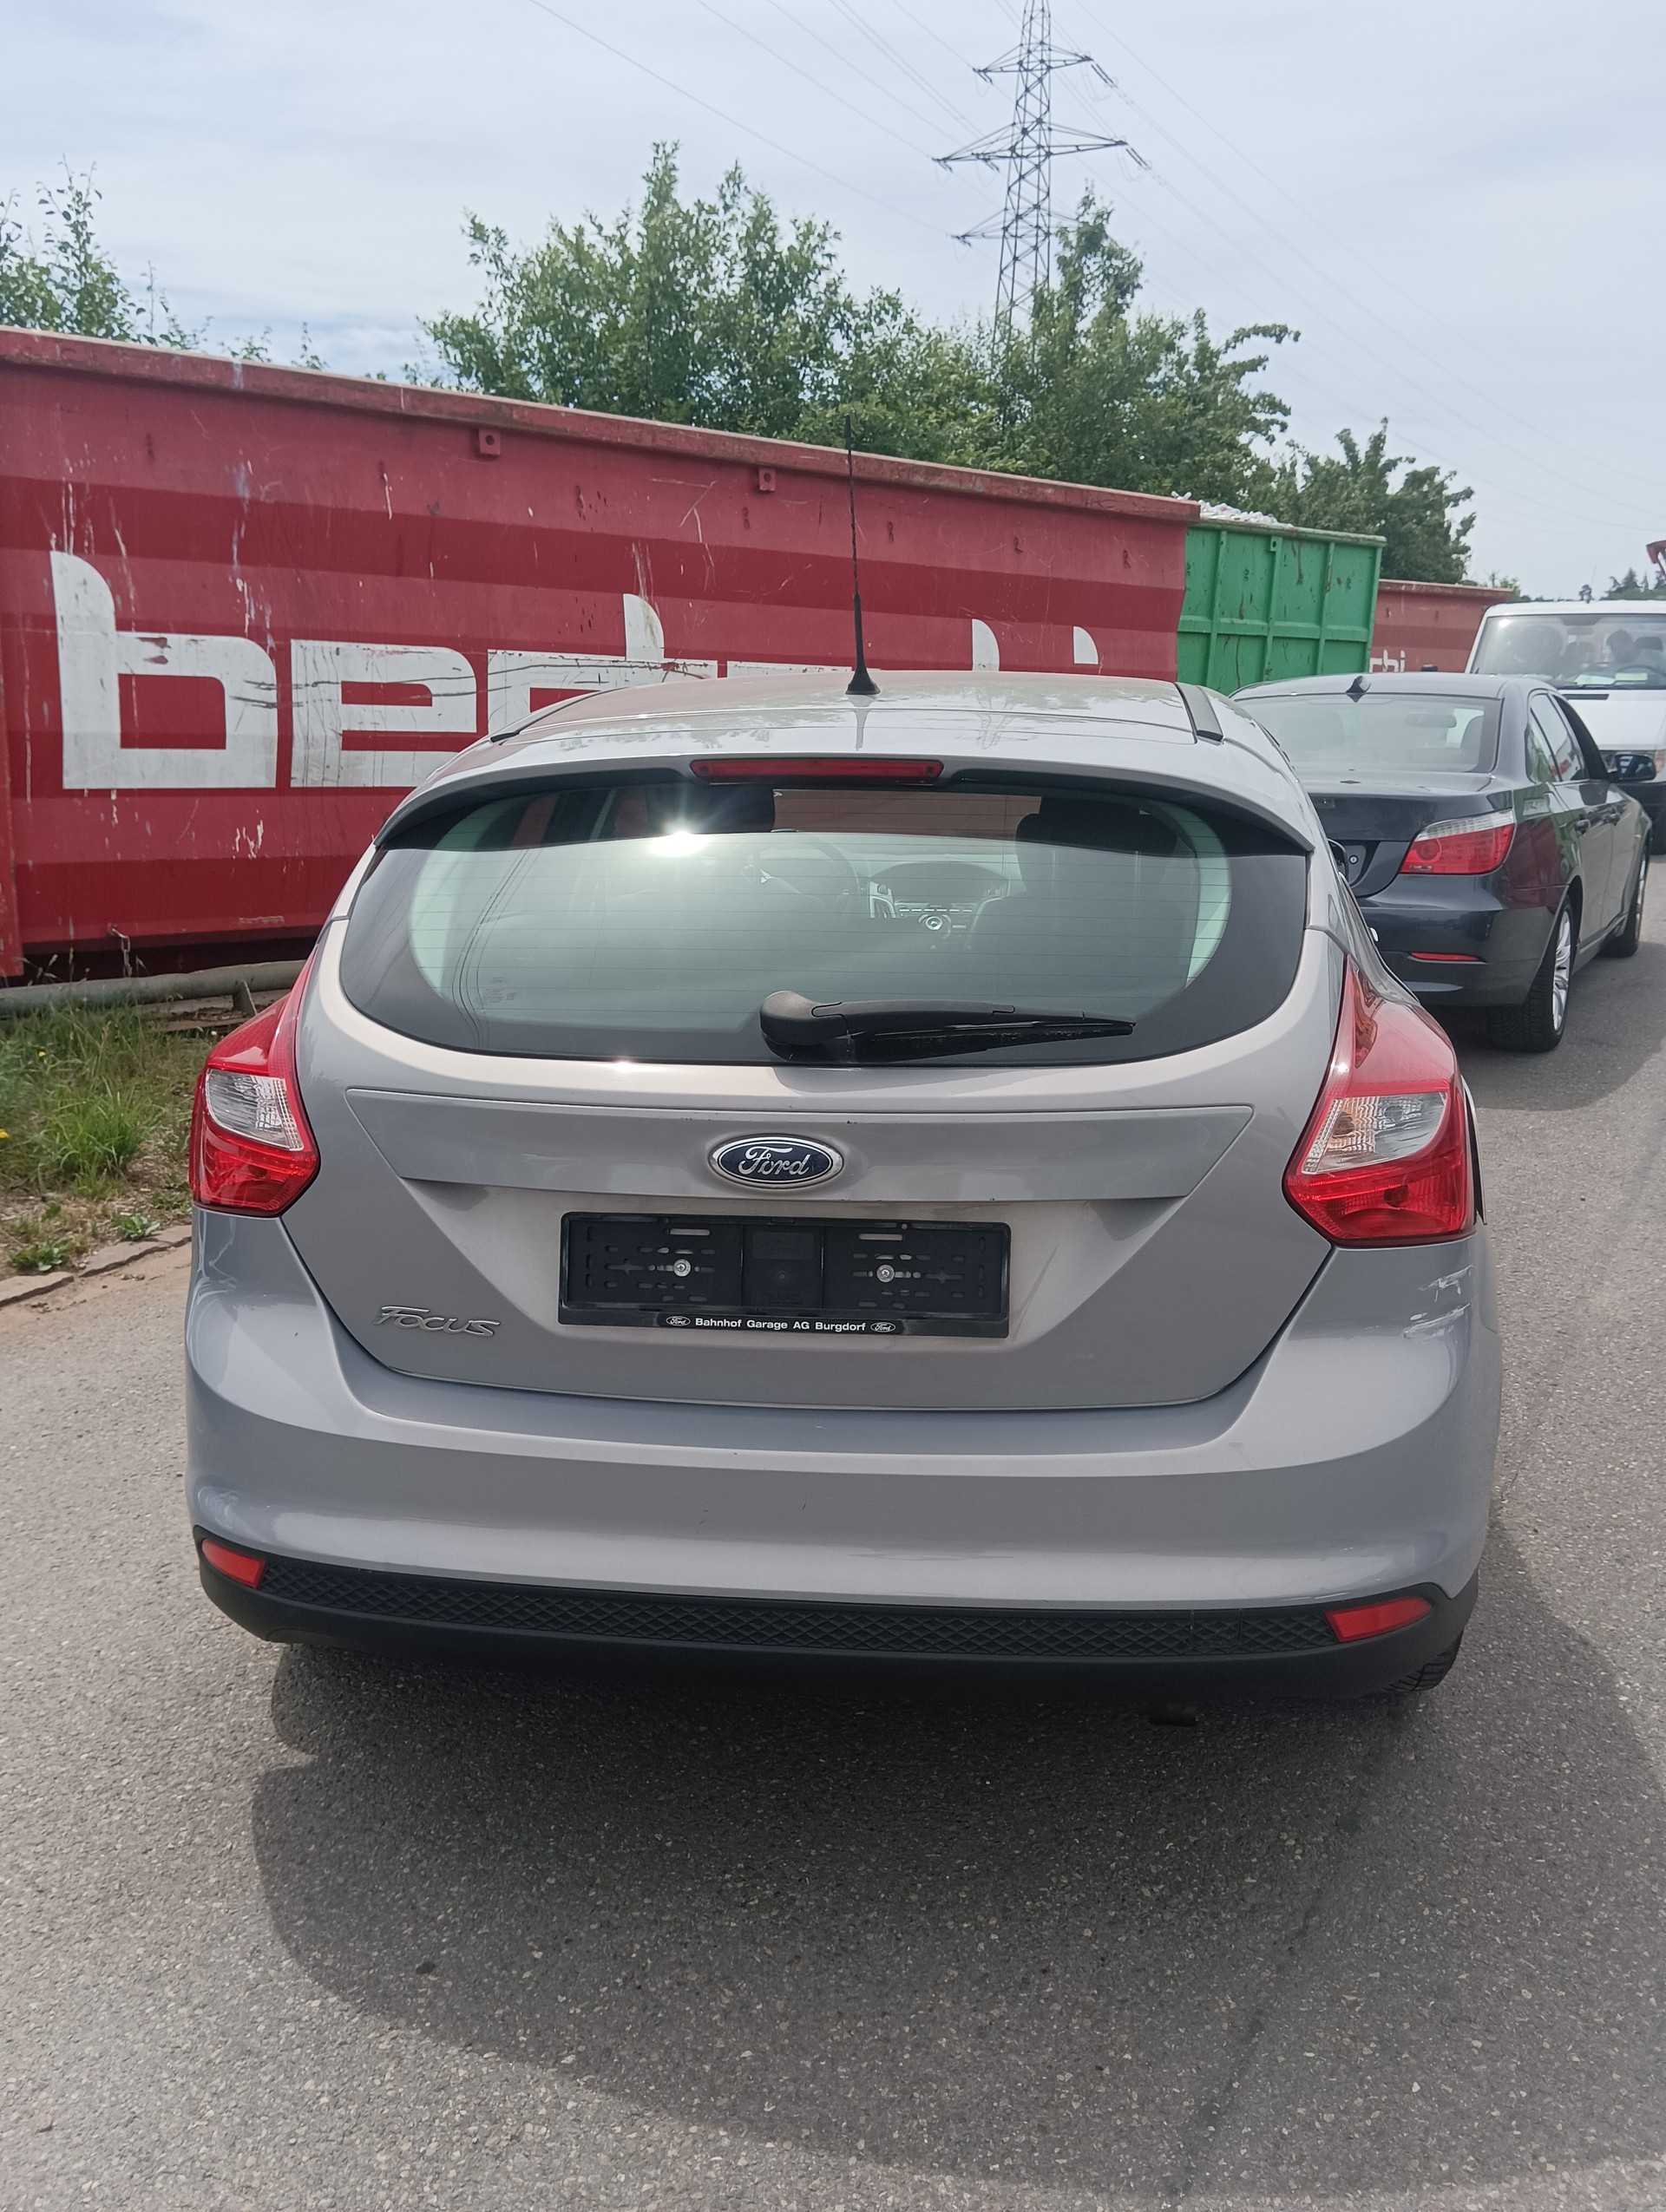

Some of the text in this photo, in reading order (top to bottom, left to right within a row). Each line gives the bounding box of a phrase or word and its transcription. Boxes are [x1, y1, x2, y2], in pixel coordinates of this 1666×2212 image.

[738, 1146, 810, 1175] Ford
[695, 1318, 742, 1328] Bahnhof
[746, 1319, 788, 1331] Garage
[793, 1321, 810, 1330] AG
[815, 1321, 866, 1332] Burgdorf
